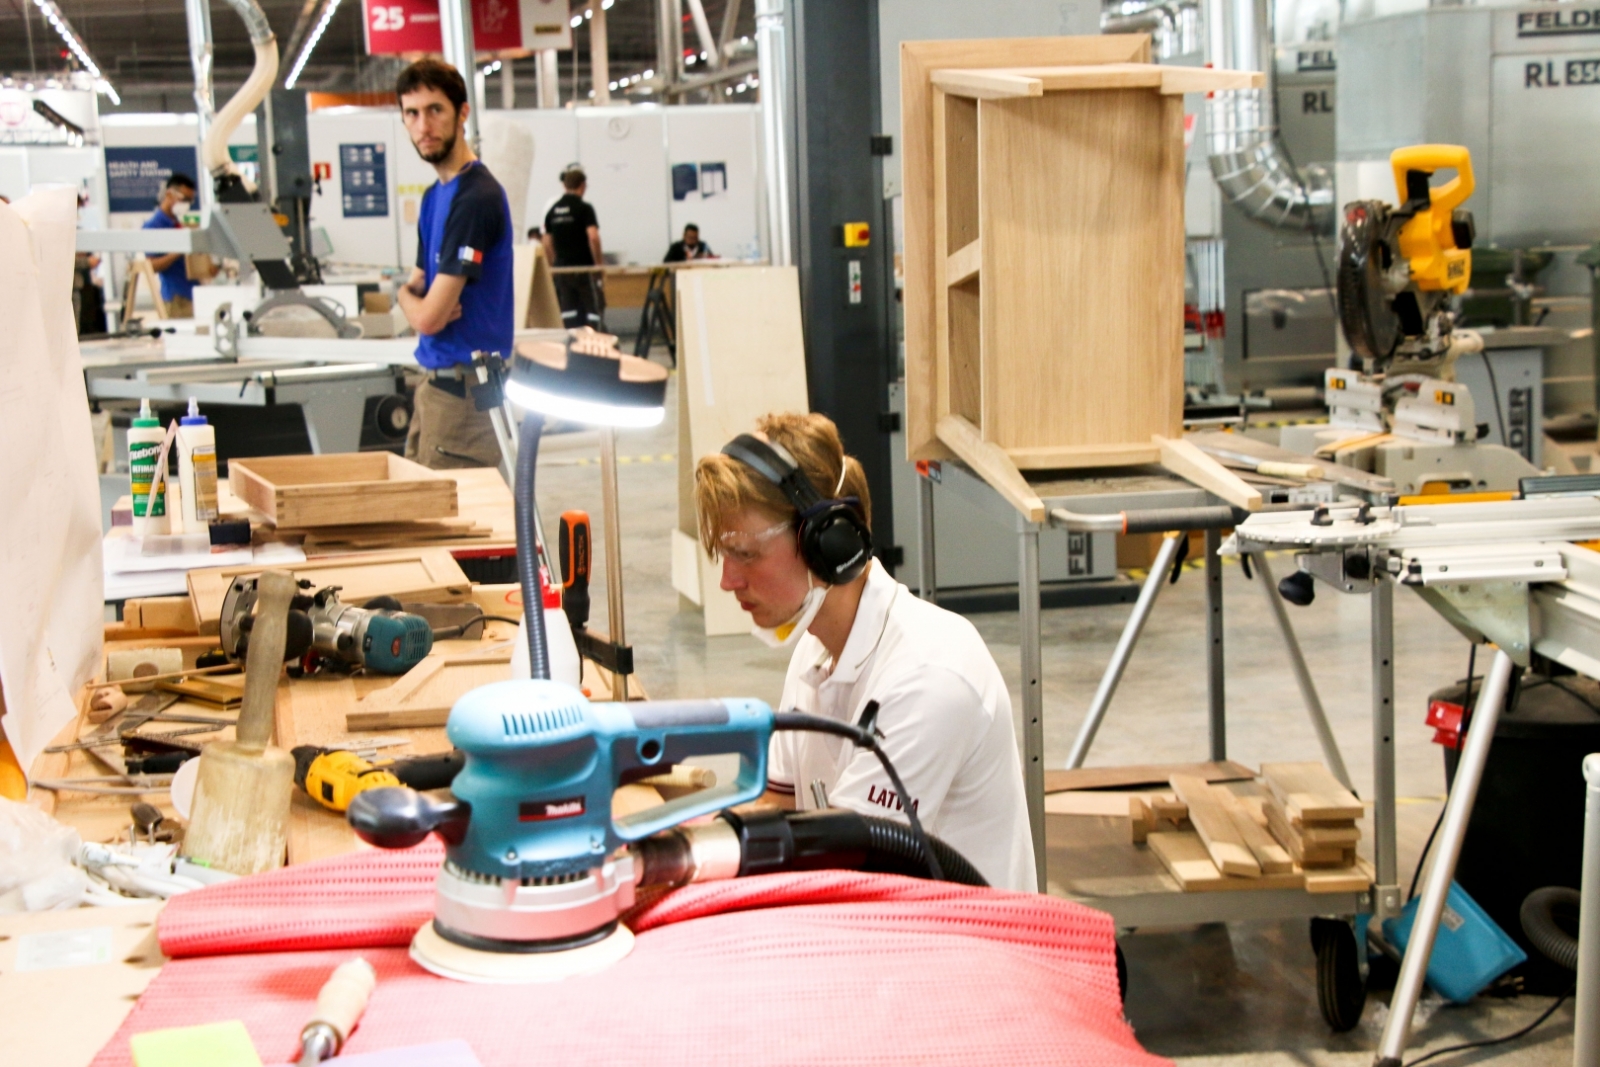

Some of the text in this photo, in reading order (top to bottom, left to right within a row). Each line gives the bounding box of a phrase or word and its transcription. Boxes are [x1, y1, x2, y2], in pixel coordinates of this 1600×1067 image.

[371, 6, 405, 31] 25
[1525, 61, 1561, 89] RL
[1303, 91, 1333, 114] RL
[867, 784, 919, 815] LATVA
